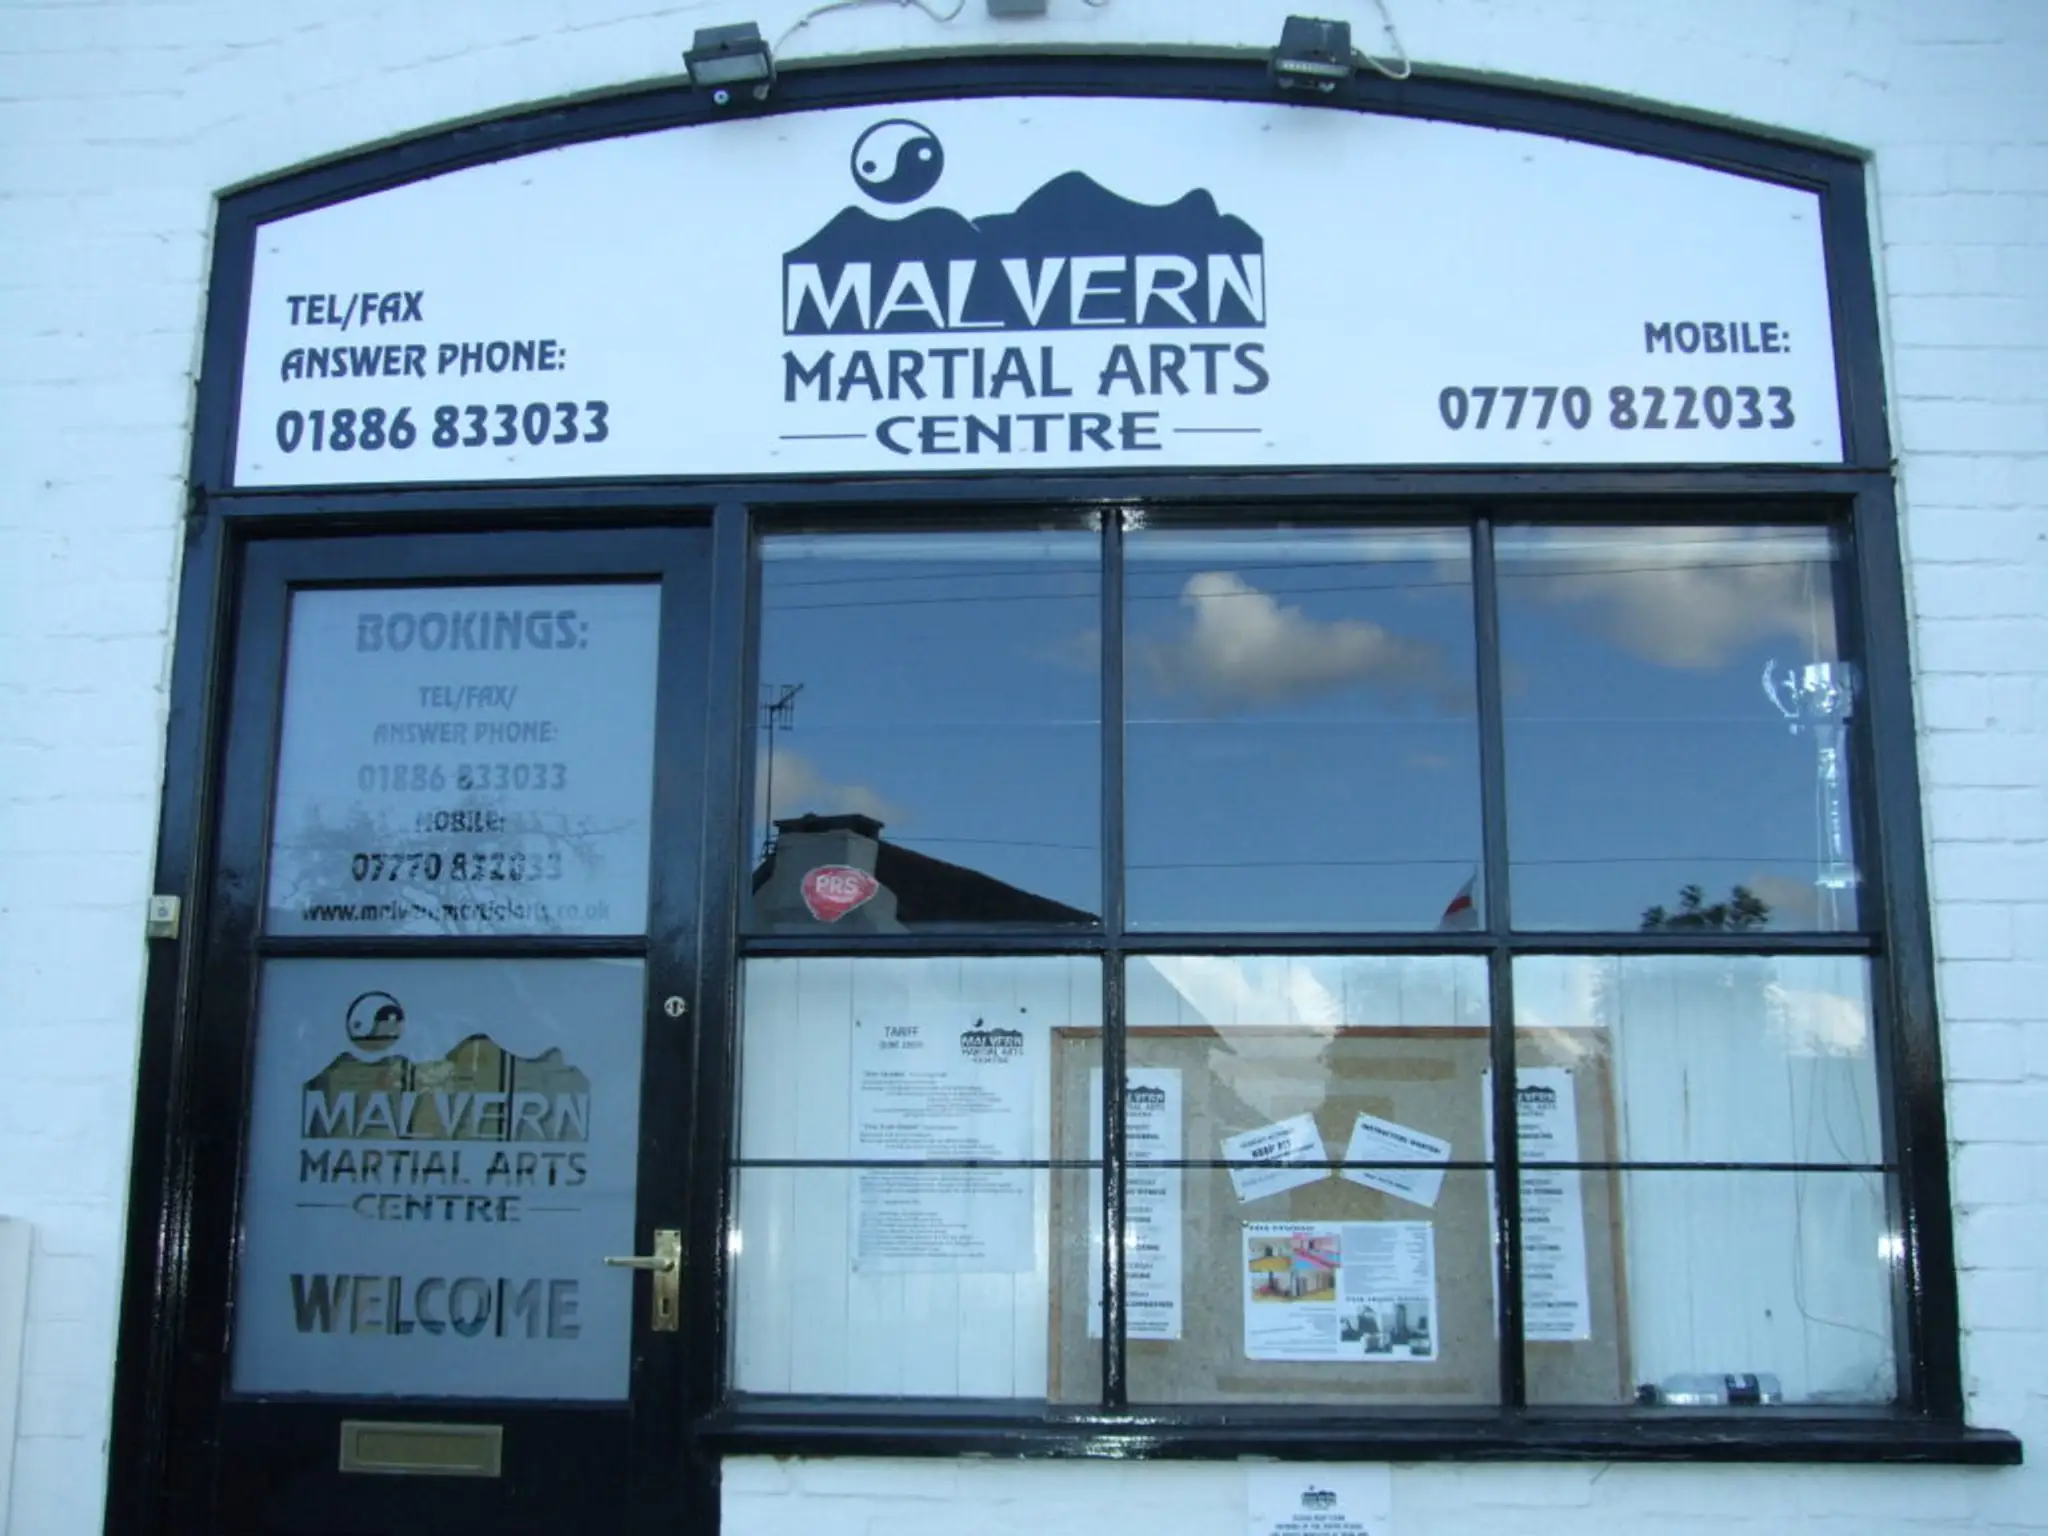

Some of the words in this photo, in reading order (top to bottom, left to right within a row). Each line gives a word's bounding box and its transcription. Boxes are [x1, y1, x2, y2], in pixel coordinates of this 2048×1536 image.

[287, 291, 424, 331] TEL/FAX
[786, 253, 1264, 330] MALVERN
[1644, 321, 1791, 353] MOBILE:
[281, 343, 426, 382] ANSWER
[437, 339, 566, 377] PHONE:
[782, 346, 1072, 402] MARTIAL
[1098, 342, 1271, 396] ARTS
[276, 406, 416, 453] 01886
[431, 400, 609, 448] 833033
[1438, 386, 1592, 430] 07770
[1608, 386, 1796, 430] 822033
[875, 411, 1162, 455] CENTRE
[356, 609, 589, 653] BOOKINGS:
[374, 722, 468, 746] ANSWER
[358, 763, 446, 793] 01886
[456, 763, 567, 791] 833033
[816, 874, 858, 894] PRS
[303, 1089, 588, 1140] MALVERN
[300, 1148, 469, 1187] MARTIAL
[485, 1150, 588, 1188] ARTS
[352, 1193, 522, 1223] CENTRE
[289, 1272, 583, 1340] WELCOME
